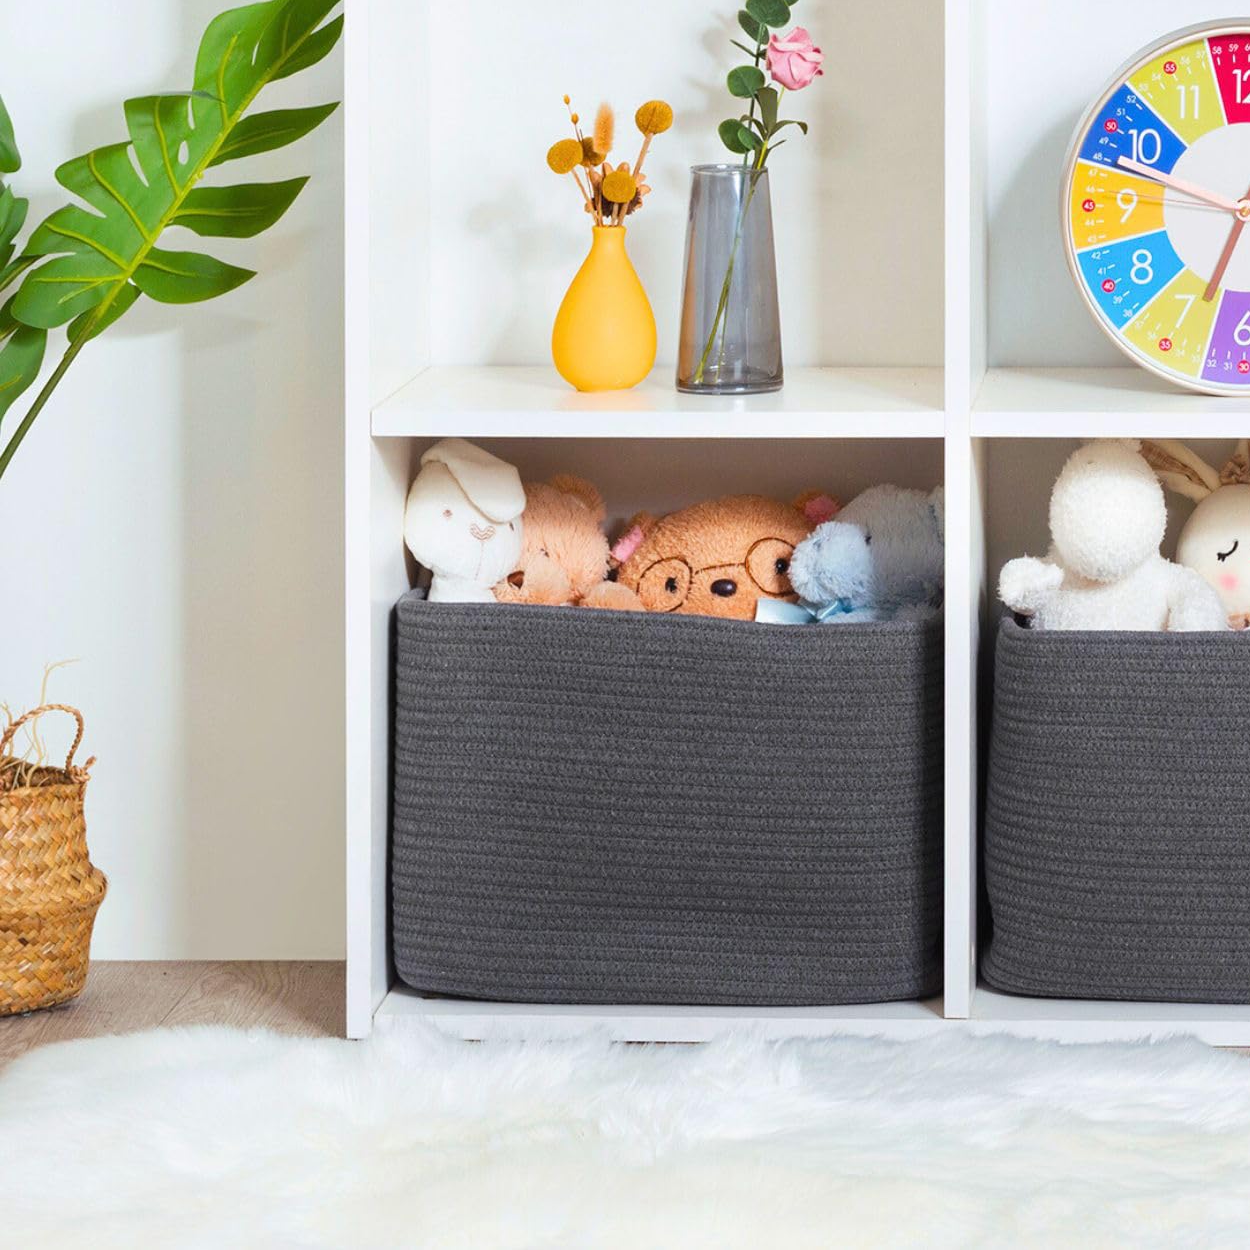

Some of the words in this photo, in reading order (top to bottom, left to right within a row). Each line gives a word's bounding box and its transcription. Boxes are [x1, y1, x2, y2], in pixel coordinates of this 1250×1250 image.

[1176, 85, 1200, 120] 11
[1128, 128, 1162, 165] 10
[1117, 188, 1138, 224] 9
[1129, 249, 1154, 285] 8
[1174, 294, 1197, 329] 7
